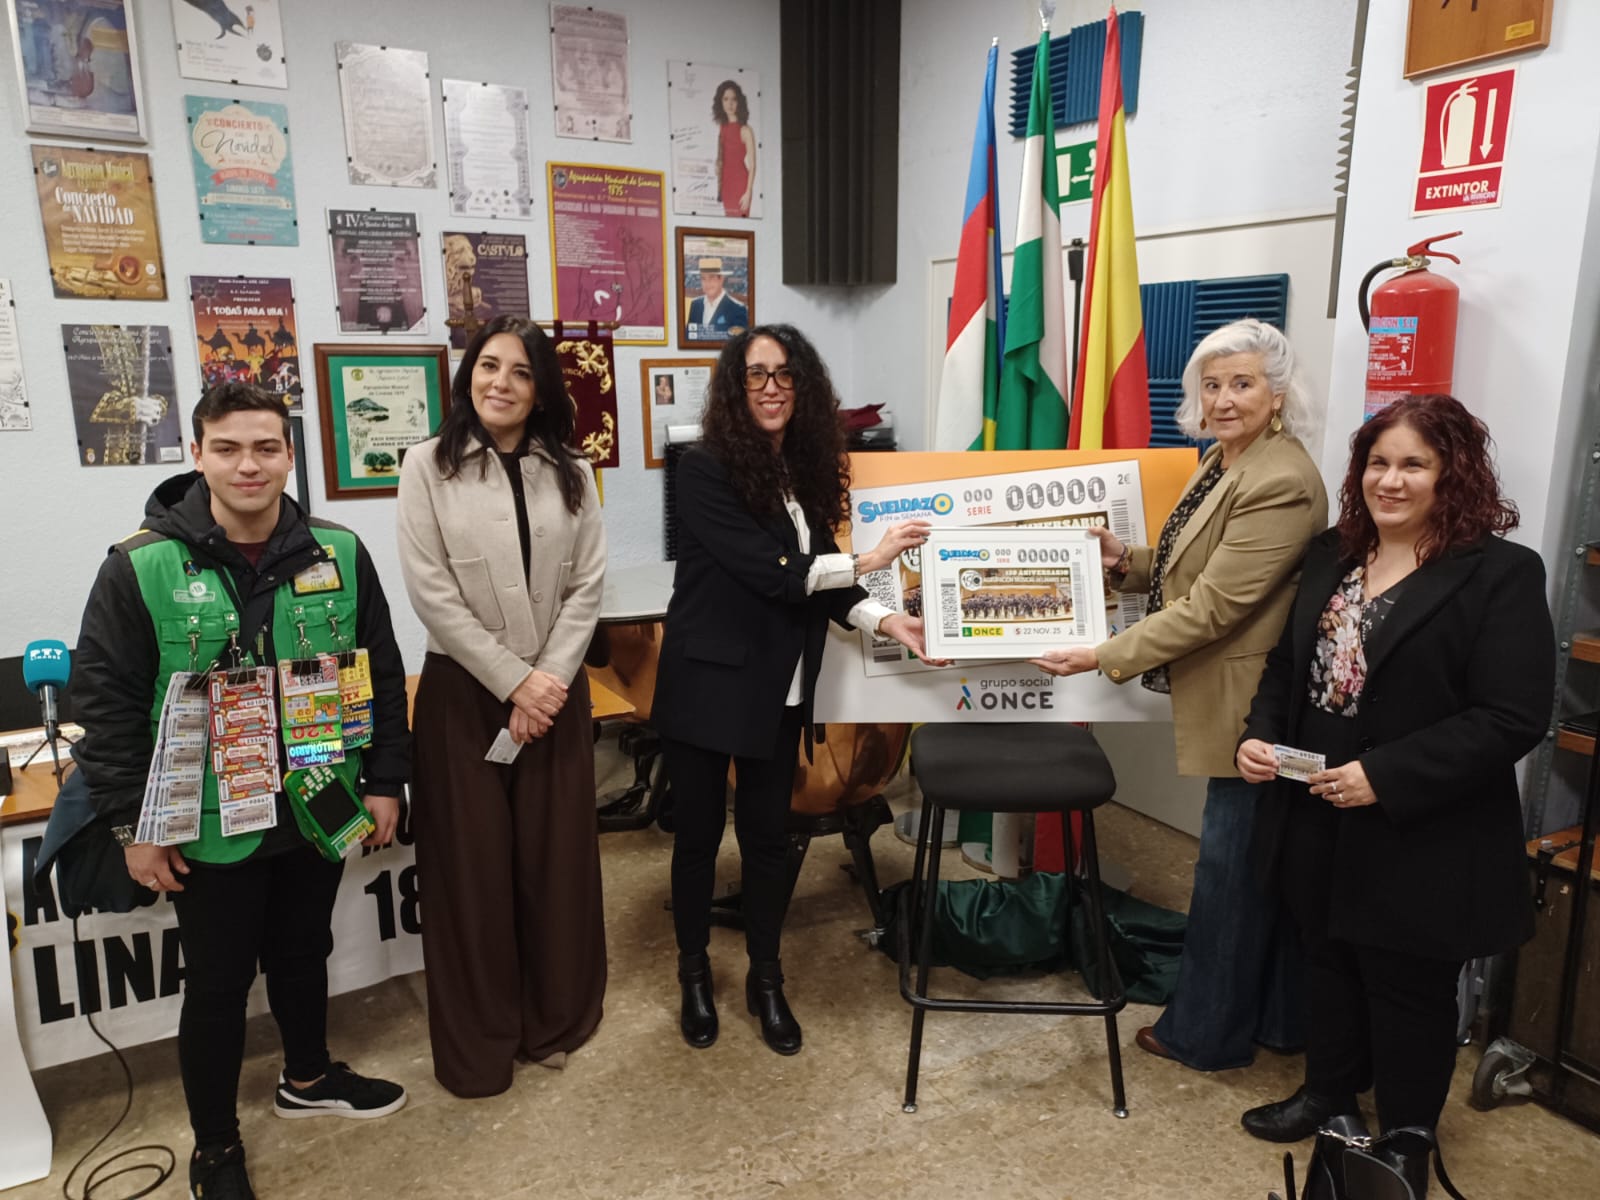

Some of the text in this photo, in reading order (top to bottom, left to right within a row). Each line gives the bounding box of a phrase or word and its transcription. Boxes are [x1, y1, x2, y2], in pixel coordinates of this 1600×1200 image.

[213, 118, 264, 131] CONCIERTO
[200, 129, 275, 161] Navidad
[55, 186, 116, 207] Concierto
[1425, 180, 1489, 200] EXTINTOR
[73, 206, 134, 225] NAVIDAD
[345, 213, 360, 228] IV
[243, 306, 266, 316] PARA
[1005, 476, 1106, 512] 00000
[857, 488, 993, 523] SUELDAZO 000
[966, 505, 992, 517] SERIE
[900, 511, 932, 520] SEMANA
[1017, 548, 1070, 564] 00000
[973, 627, 1003, 636] ONCE
[1023, 627, 1032, 635] 22
[980, 677, 1054, 690] grupo social
[980, 691, 1054, 711] ONCE
[33, 926, 187, 1025] LINA
